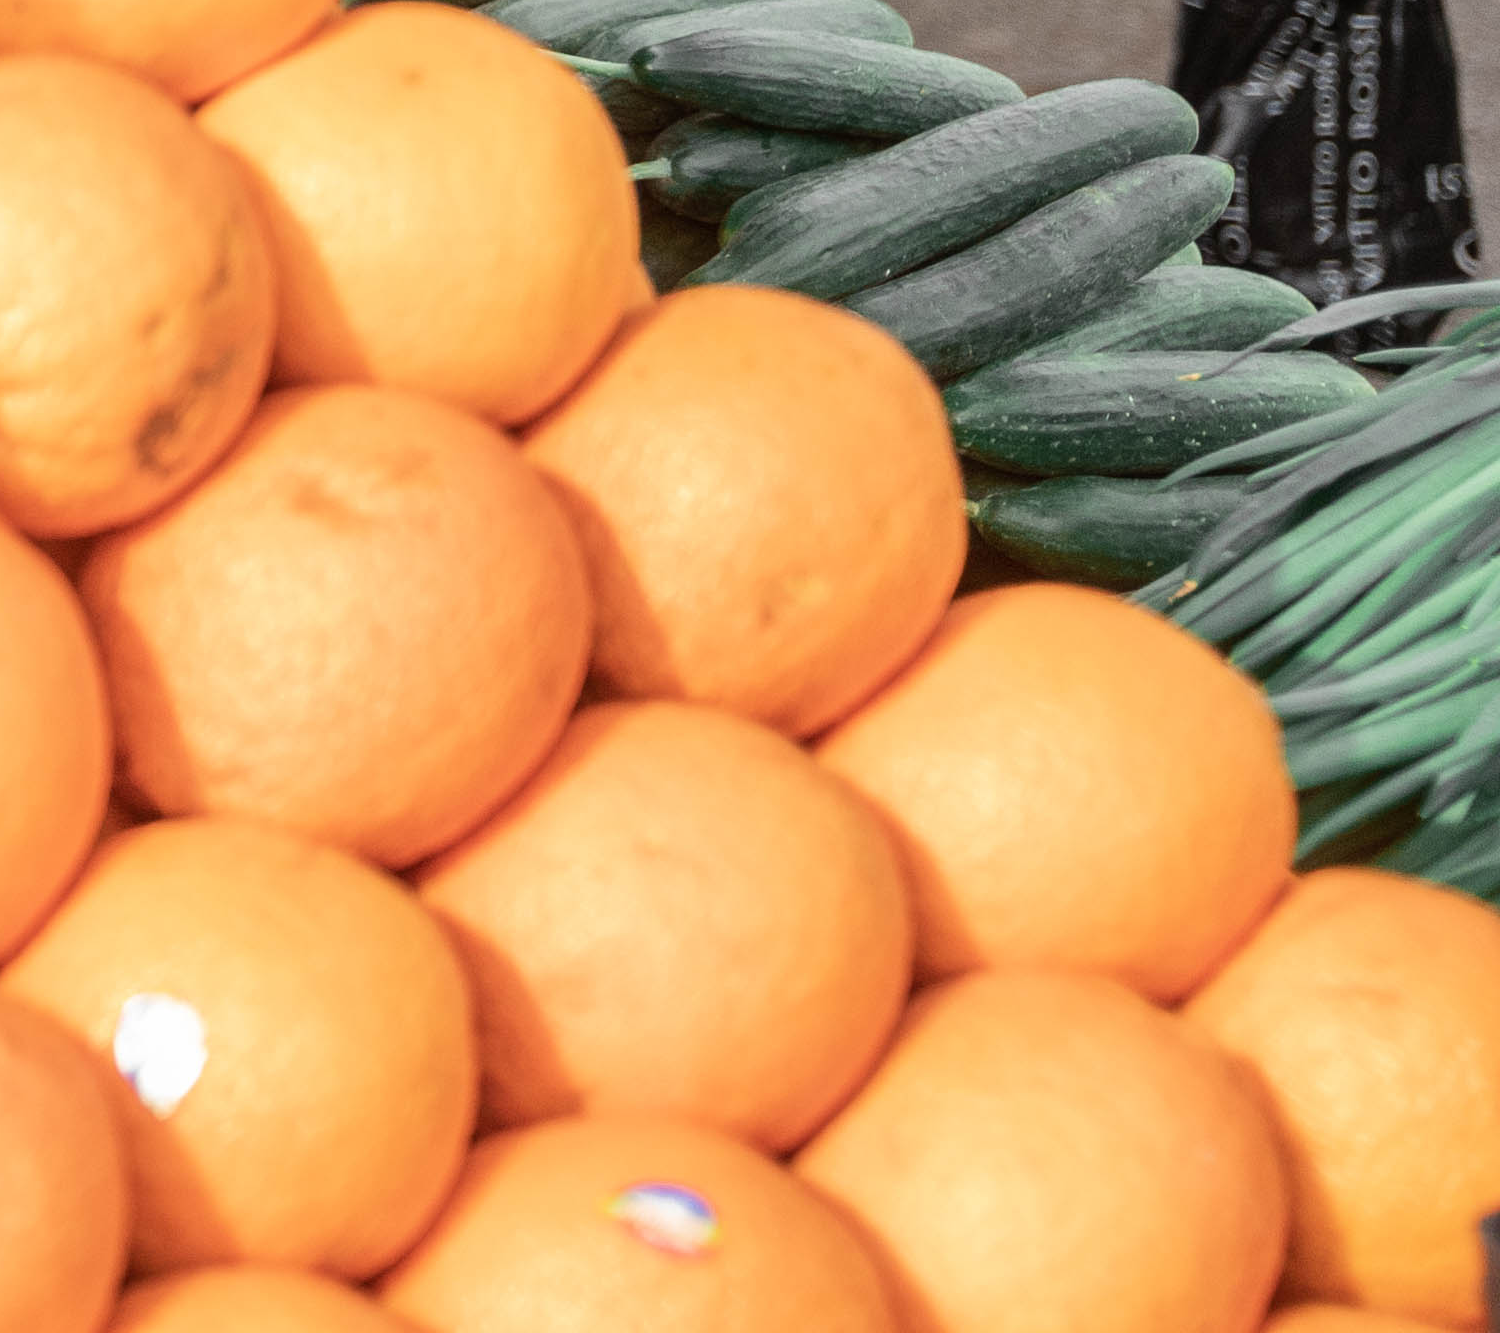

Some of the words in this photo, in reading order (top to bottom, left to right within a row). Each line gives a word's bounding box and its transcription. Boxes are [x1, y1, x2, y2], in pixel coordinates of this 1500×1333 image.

[1348, 14, 1382, 140] ROSSI
[1312, 140, 1340, 246] VITTO
[1347, 150, 1386, 293] VITTO
